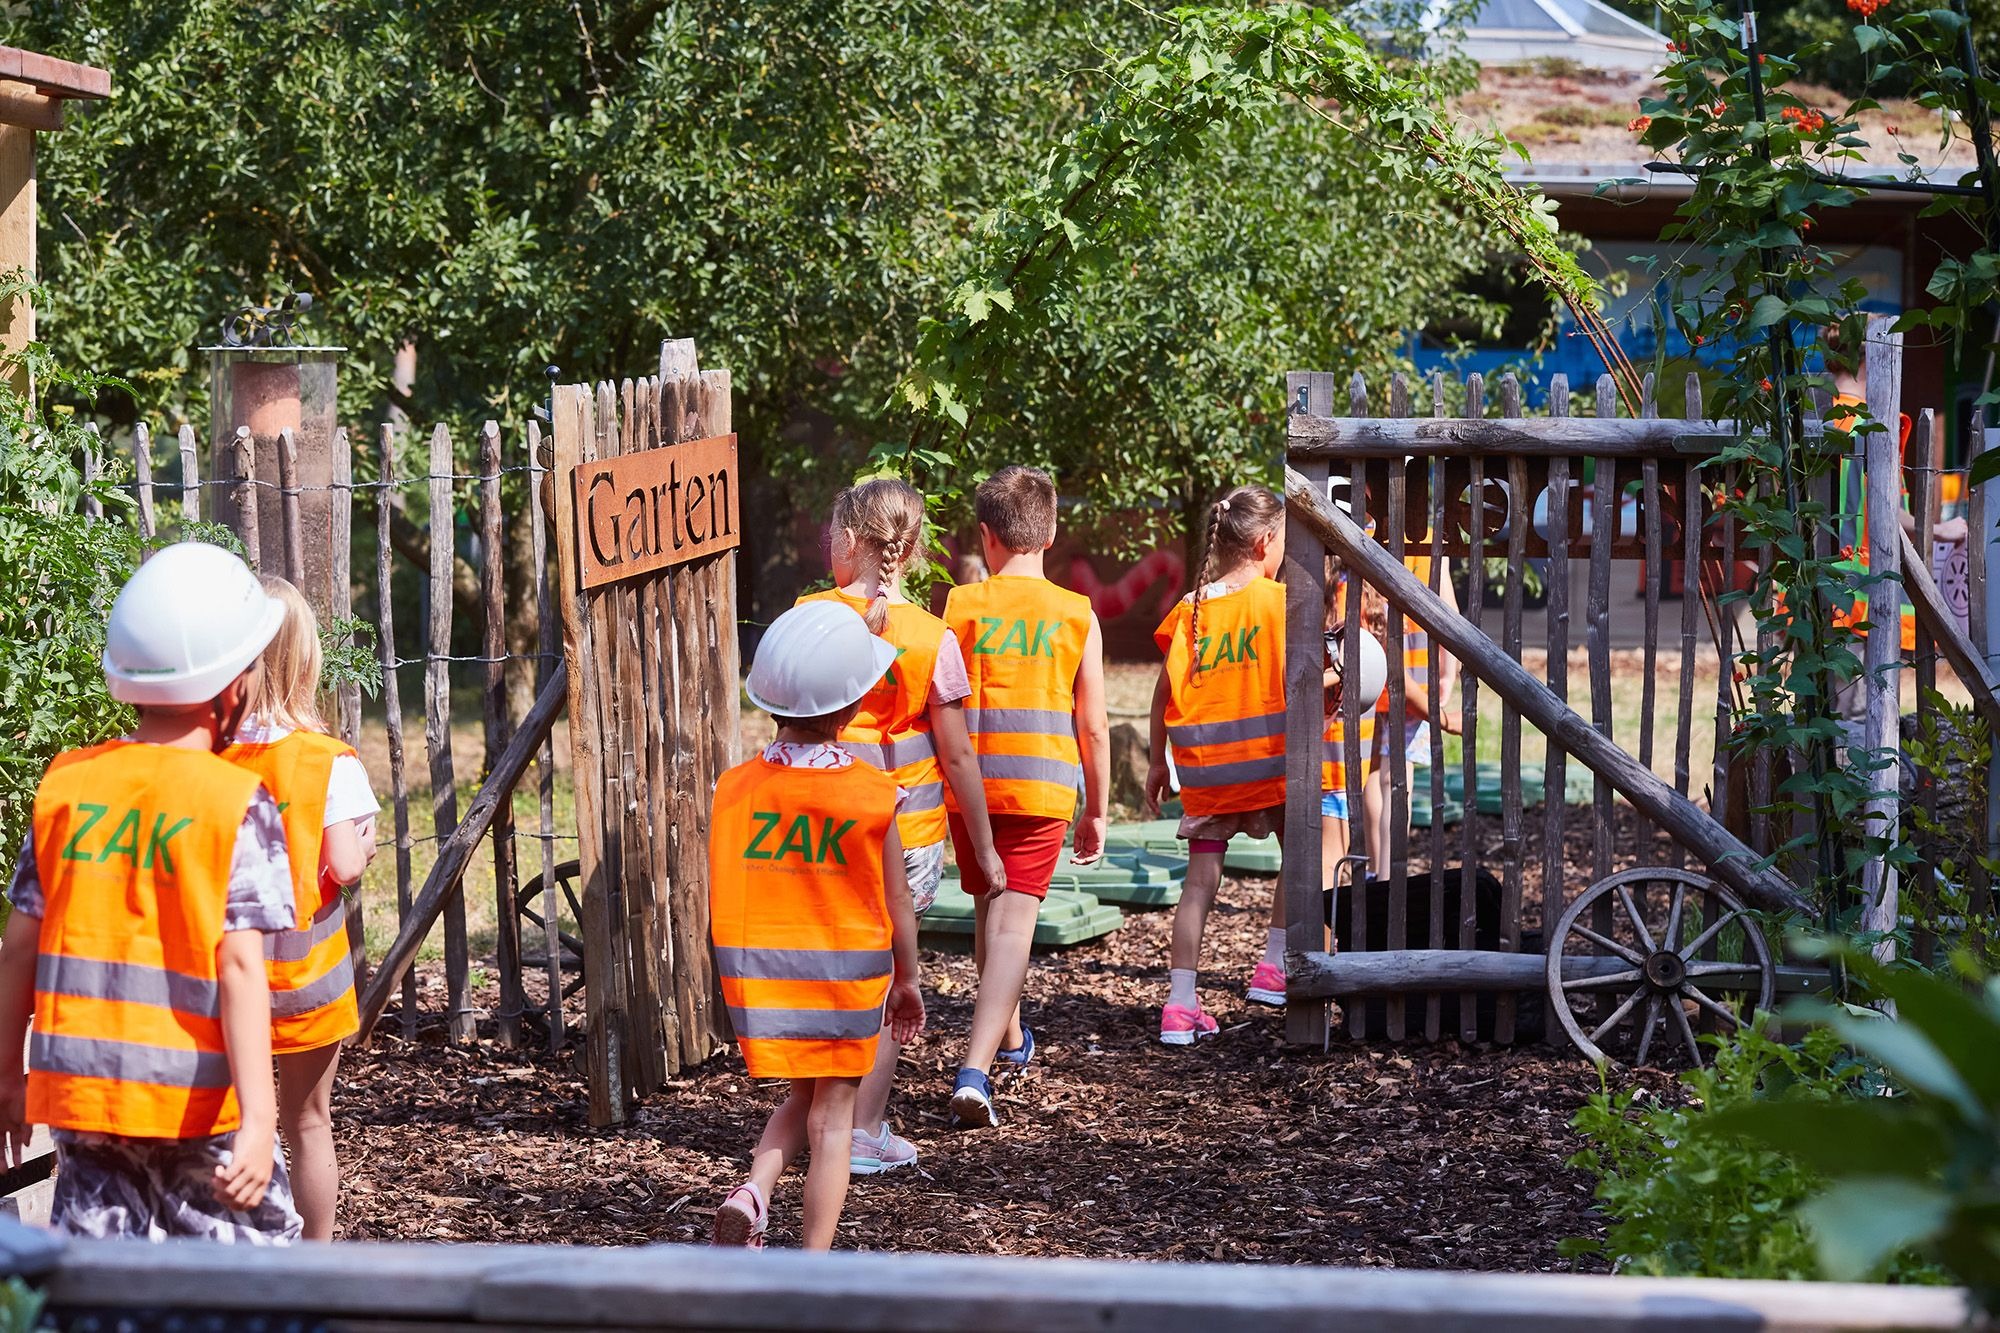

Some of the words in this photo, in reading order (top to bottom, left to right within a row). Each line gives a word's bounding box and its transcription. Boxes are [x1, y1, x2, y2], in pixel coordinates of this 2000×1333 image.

[587, 459, 732, 567] Garten
[973, 616, 1063, 658] ZAK
[1196, 625, 1261, 672] ZAK
[62, 803, 194, 874] ZAK
[743, 811, 857, 865] ZAK
